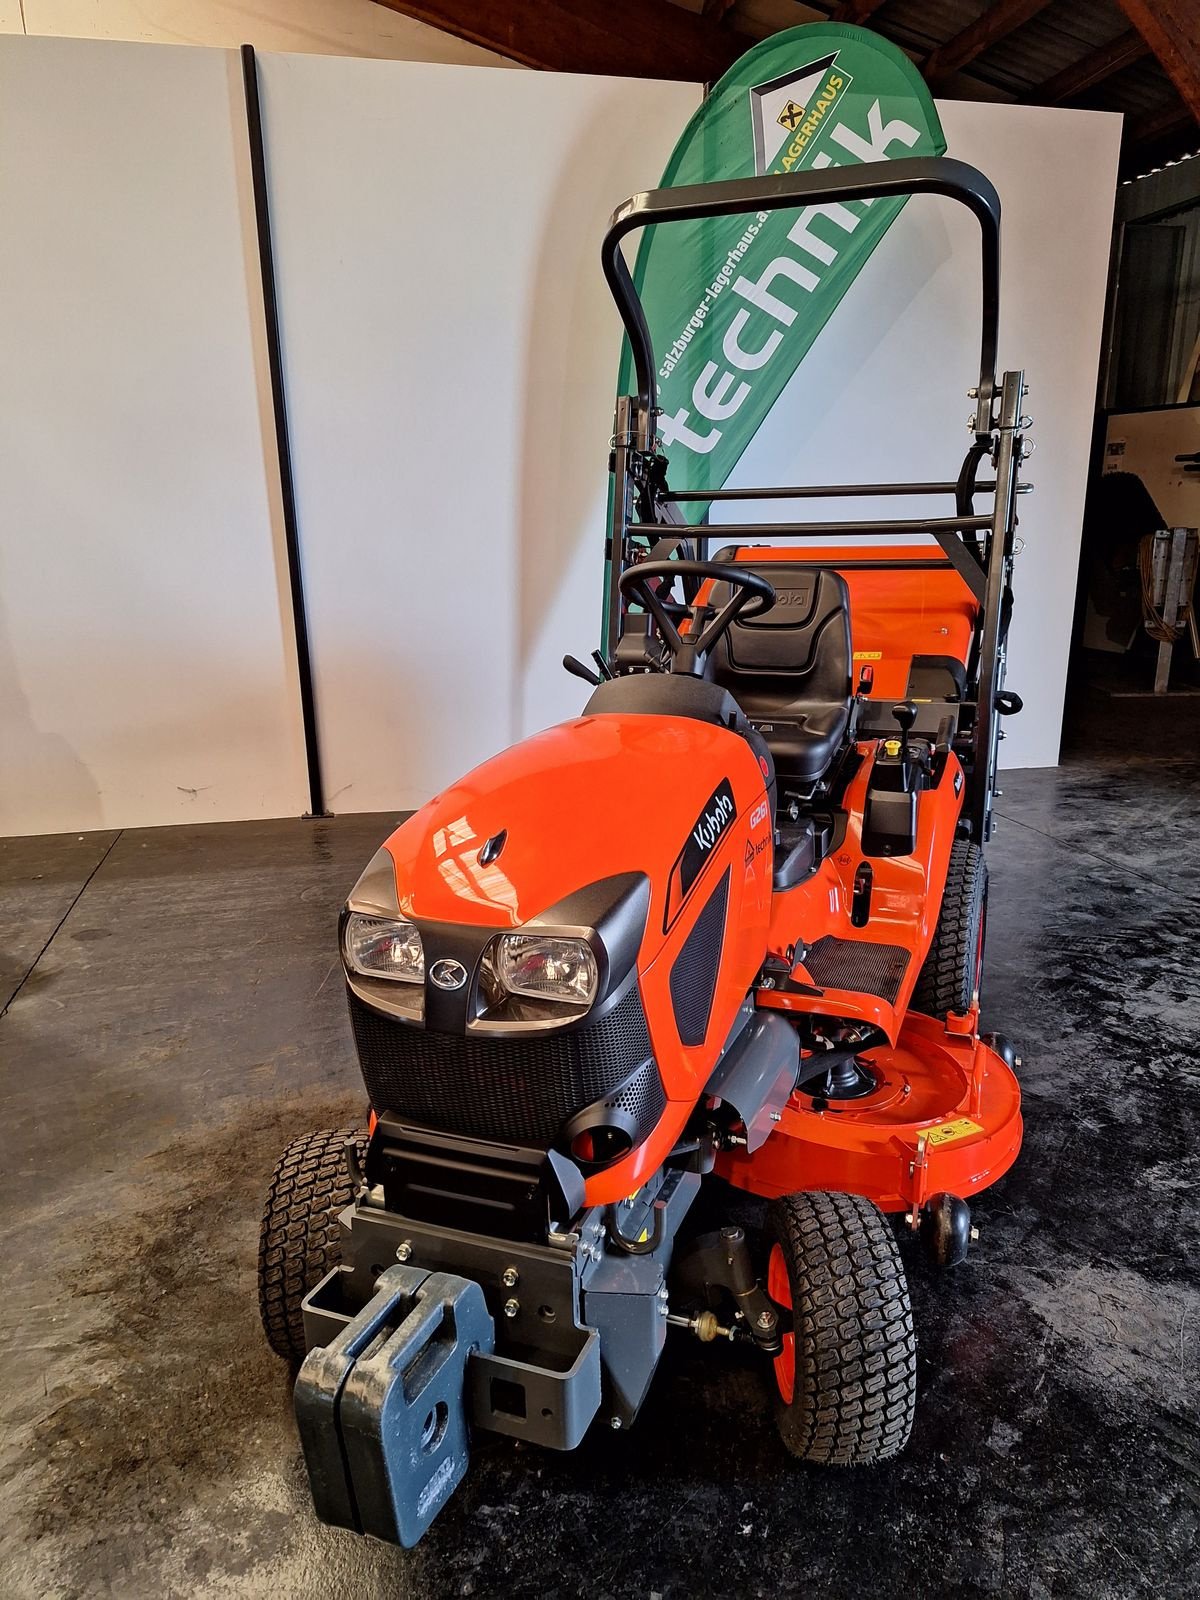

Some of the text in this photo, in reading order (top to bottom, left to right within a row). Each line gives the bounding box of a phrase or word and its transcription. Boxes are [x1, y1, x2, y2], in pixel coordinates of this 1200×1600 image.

[774, 74, 844, 174] AGERHAUS
[659, 210, 772, 379] salzburger-lagerhaus.a
[693, 795, 733, 850] Kubota
